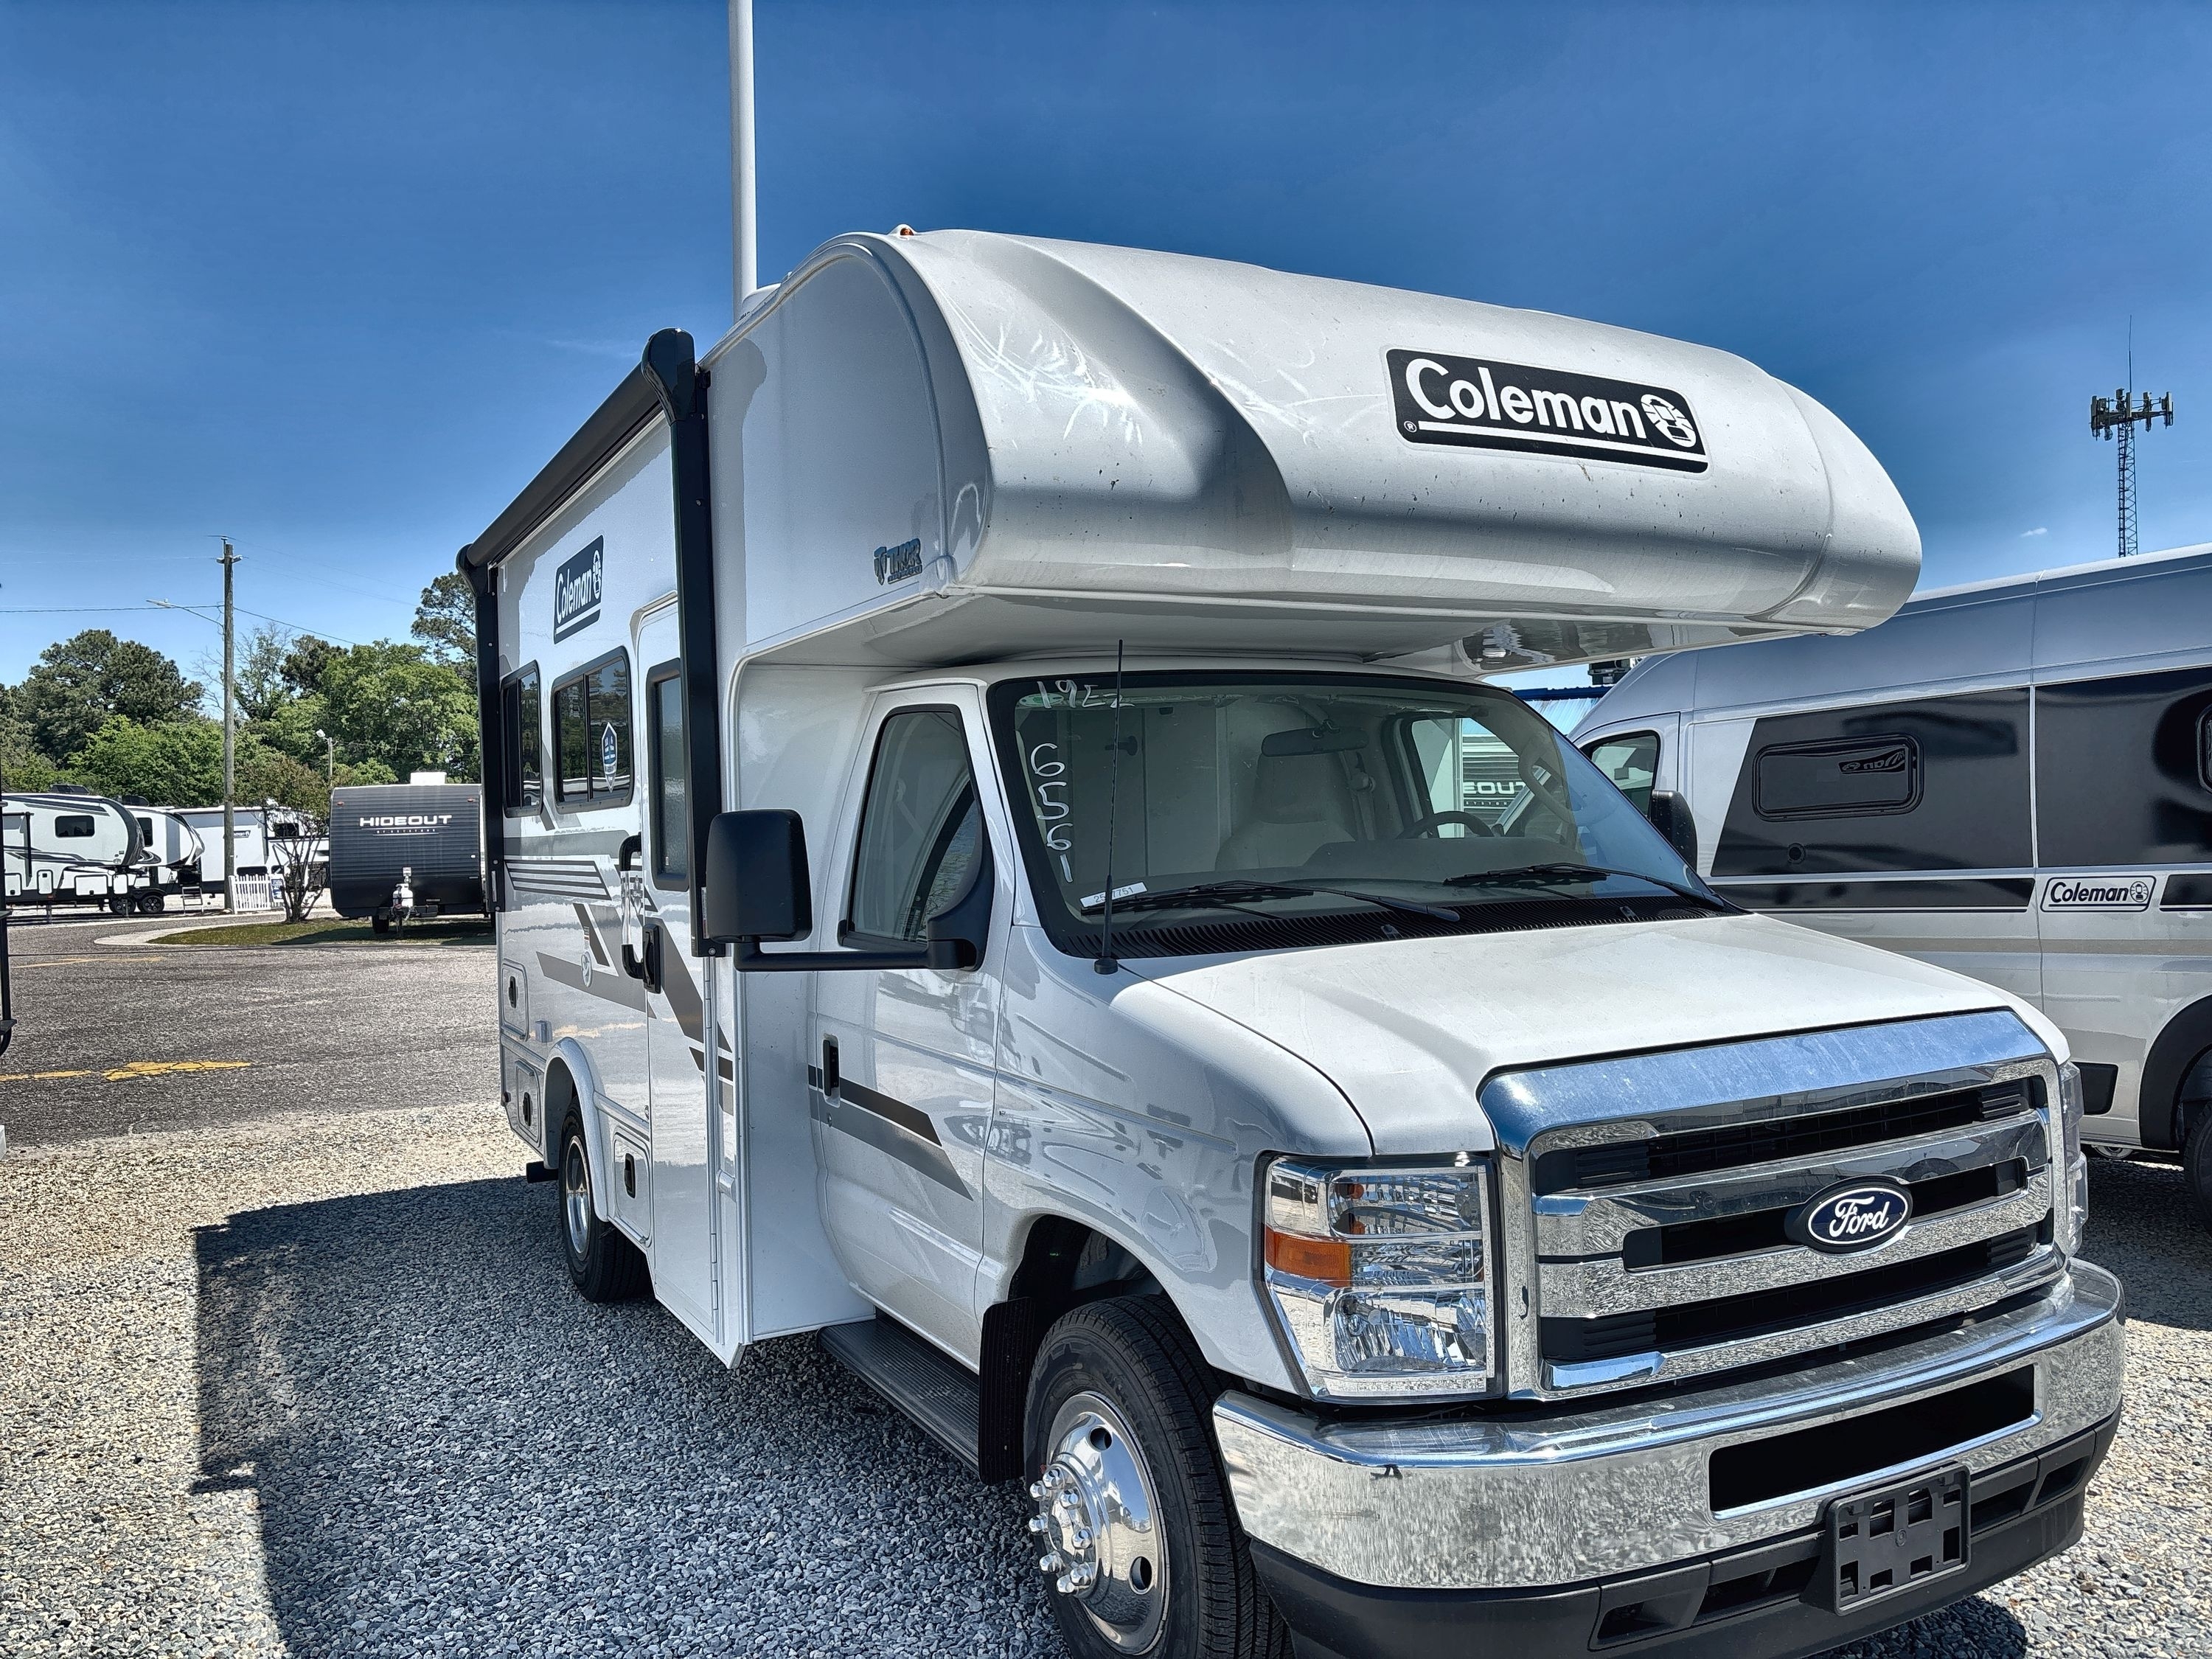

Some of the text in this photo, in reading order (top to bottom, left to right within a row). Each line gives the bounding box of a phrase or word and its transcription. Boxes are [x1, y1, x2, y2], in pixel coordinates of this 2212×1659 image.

[1405, 358, 1647, 439] Coleman
[887, 538, 922, 575] THOR
[556, 568, 592, 625] Coleman
[359, 815, 453, 827] HIDEOUT
[1029, 742, 1075, 883] 6561
[1093, 886, 1134, 903] 257751
[2050, 881, 2129, 903] Coleman
[1829, 1196, 1890, 1237] Ford
